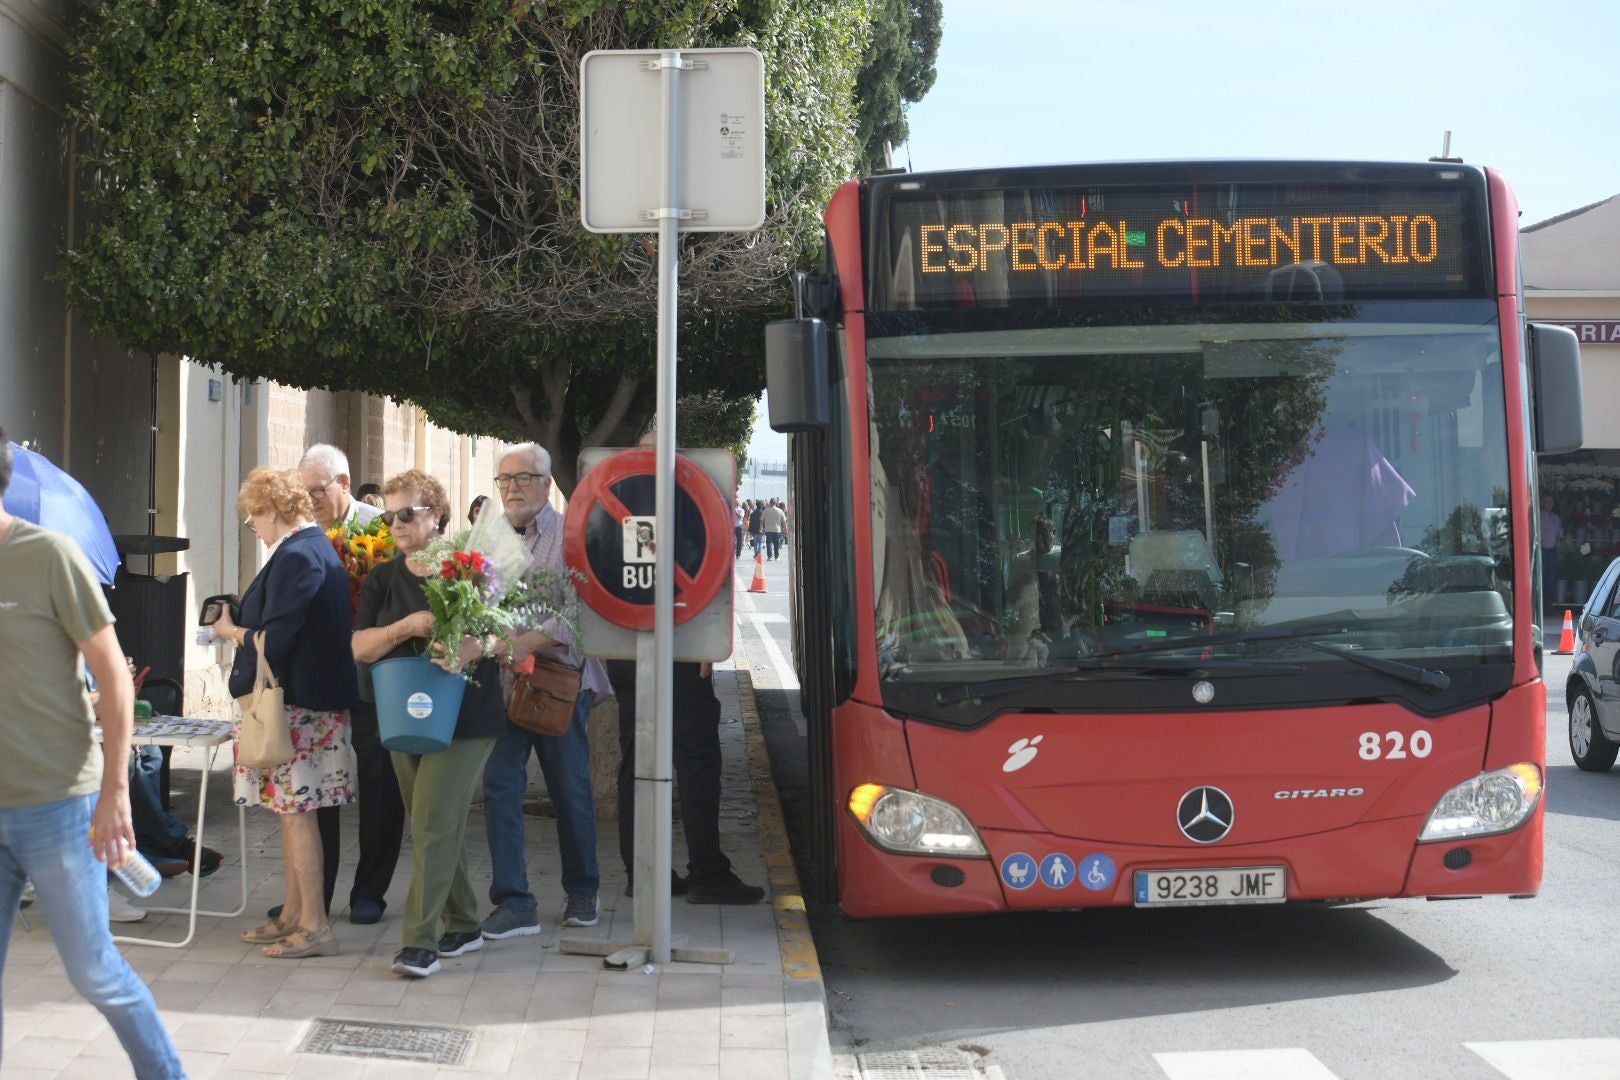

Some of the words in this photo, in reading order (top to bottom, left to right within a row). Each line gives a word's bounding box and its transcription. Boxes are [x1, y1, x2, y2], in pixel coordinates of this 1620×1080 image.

[920, 220, 1145, 272] ESPECIAL
[1156, 215, 1438, 267] CEMENTERIO
[1563, 324, 1620, 341] RIA
[623, 565, 656, 589] BU
[1358, 729, 1433, 760] 820
[1273, 787, 1364, 799] CITARO
[1139, 890, 1146, 898] E
[1156, 875, 1219, 899] 9238
[1230, 872, 1276, 897] JMF
